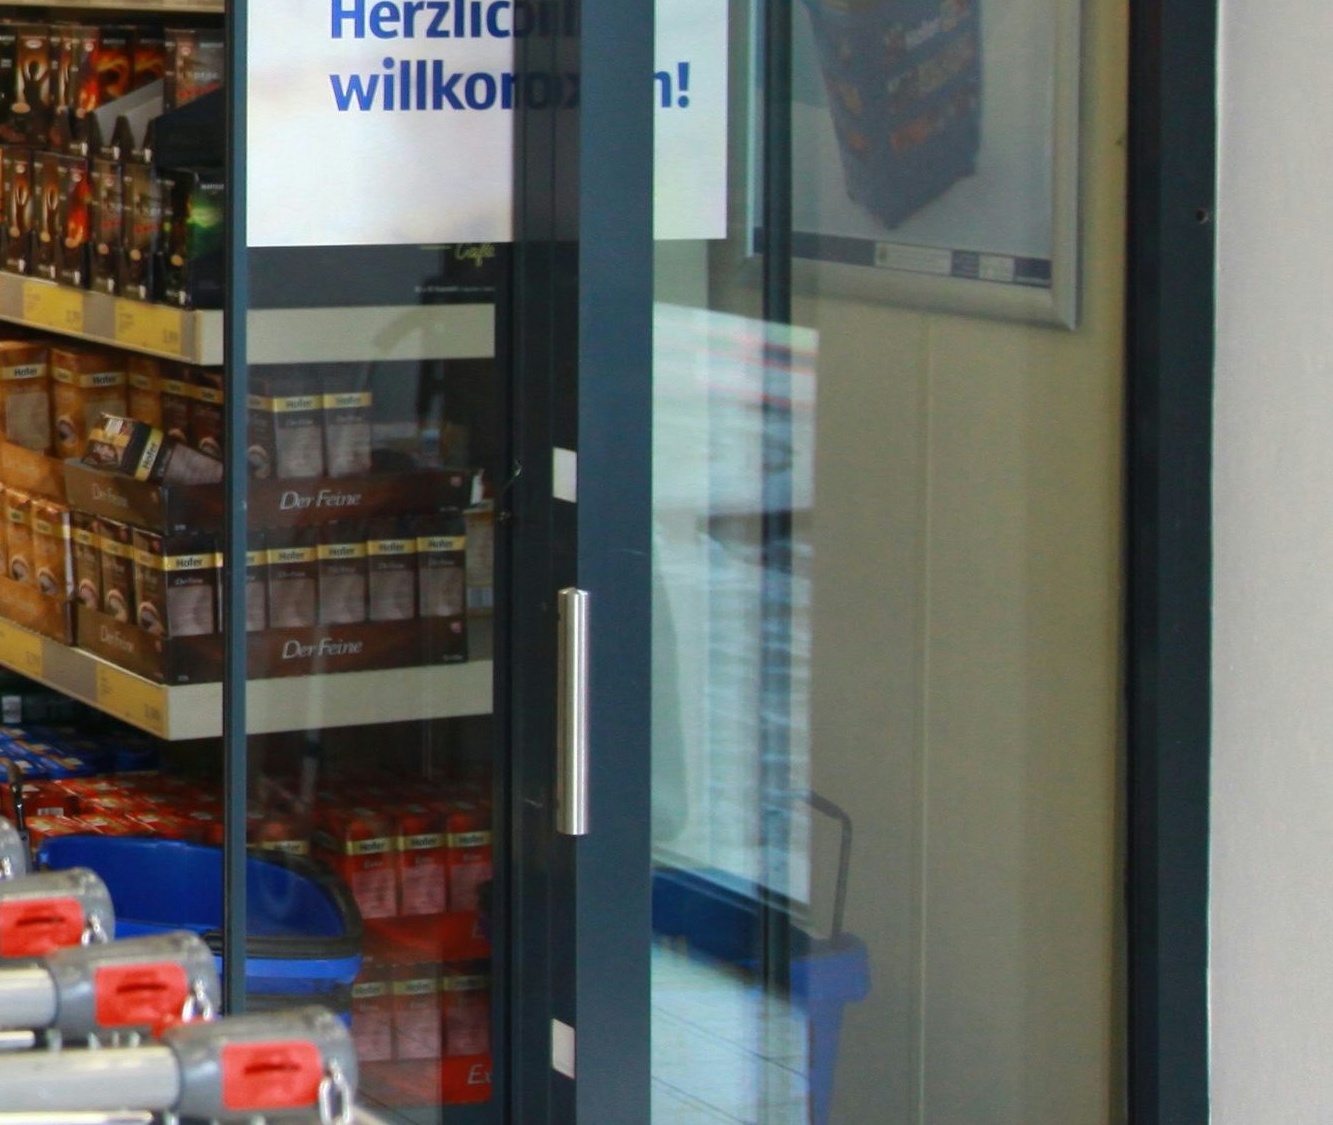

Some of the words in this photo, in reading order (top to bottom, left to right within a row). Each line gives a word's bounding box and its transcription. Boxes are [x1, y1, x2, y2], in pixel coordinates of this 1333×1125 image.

[13, 365, 39, 378] Hofer
[92, 373, 118, 386] Hofer
[175, 557, 203, 568] Hofer
